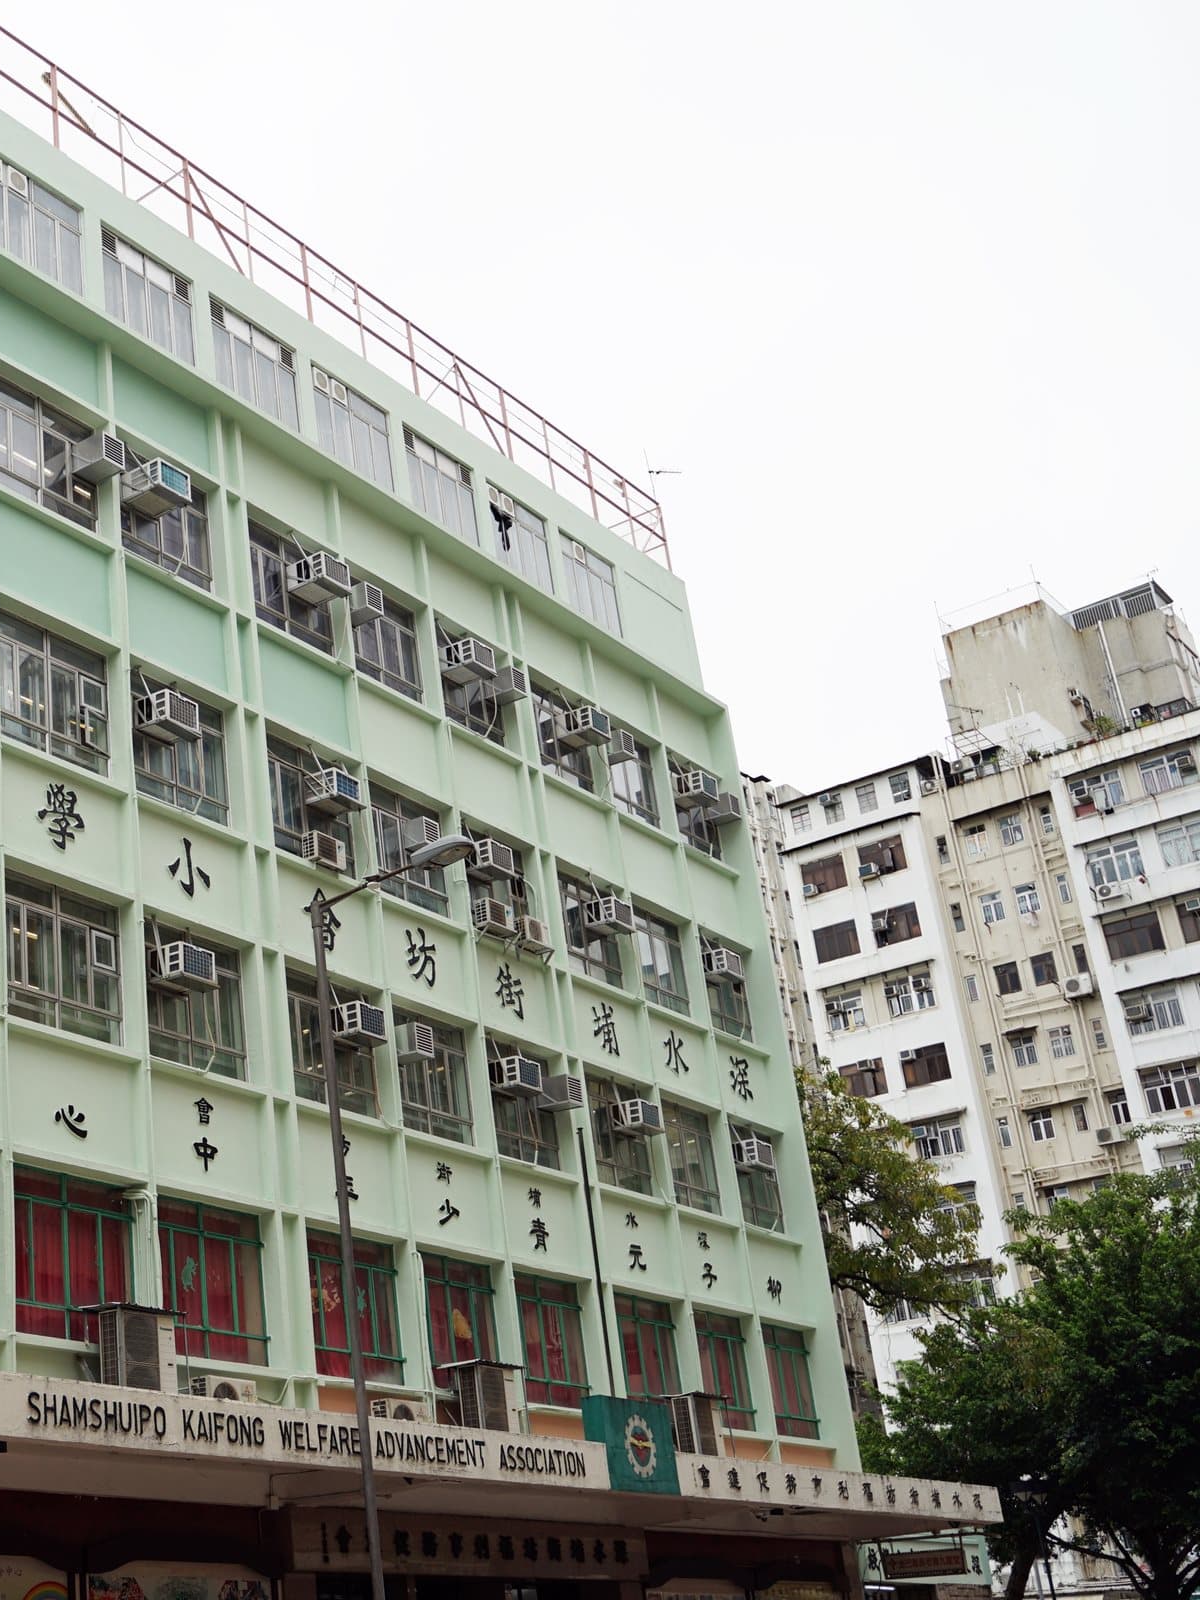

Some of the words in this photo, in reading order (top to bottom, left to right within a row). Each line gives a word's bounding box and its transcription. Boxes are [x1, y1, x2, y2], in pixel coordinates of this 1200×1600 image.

[27, 1391, 166, 1439] SHAMSHUIPO
[182, 1408, 265, 1446] KAIFONG
[278, 1418, 361, 1456] WELFARE
[375, 1430, 485, 1468] ADVANCEMENT
[500, 1444, 586, 1477] ASSOCIATION
